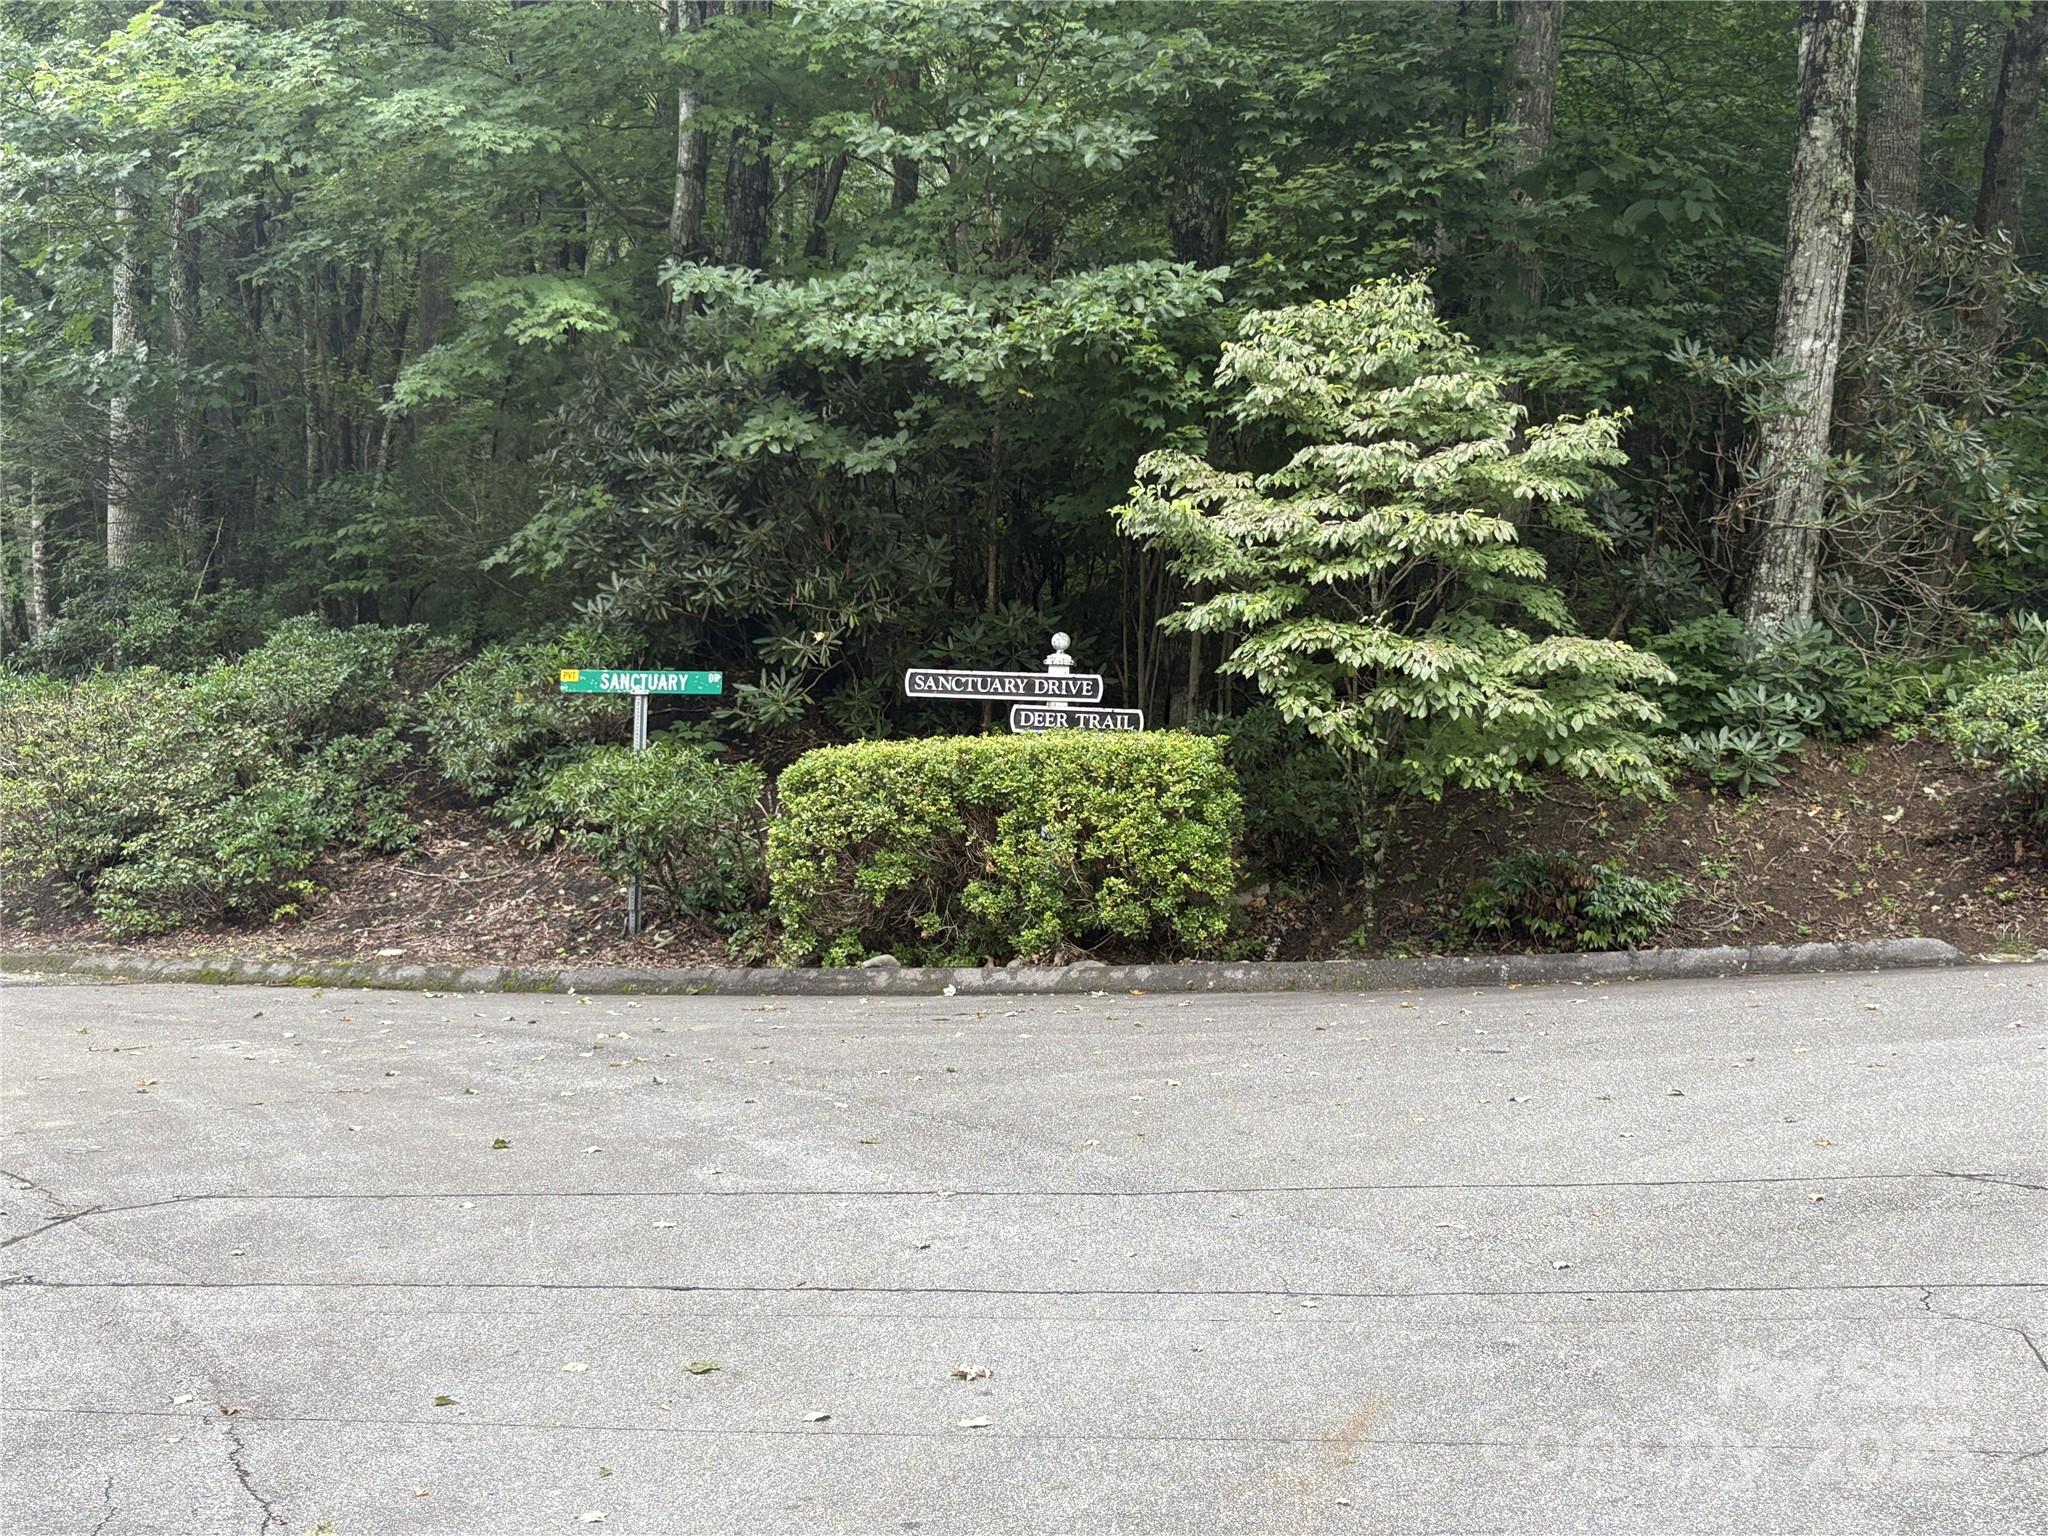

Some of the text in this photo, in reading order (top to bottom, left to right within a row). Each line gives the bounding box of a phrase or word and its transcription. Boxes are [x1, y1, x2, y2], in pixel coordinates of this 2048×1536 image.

[563, 671, 576, 680] PVT
[600, 672, 688, 691] SANCTUARY
[708, 673, 721, 684] DR
[914, 675, 1093, 696] SANCTUARY DRIVE
[1020, 711, 1135, 730] DEER TRAIL
